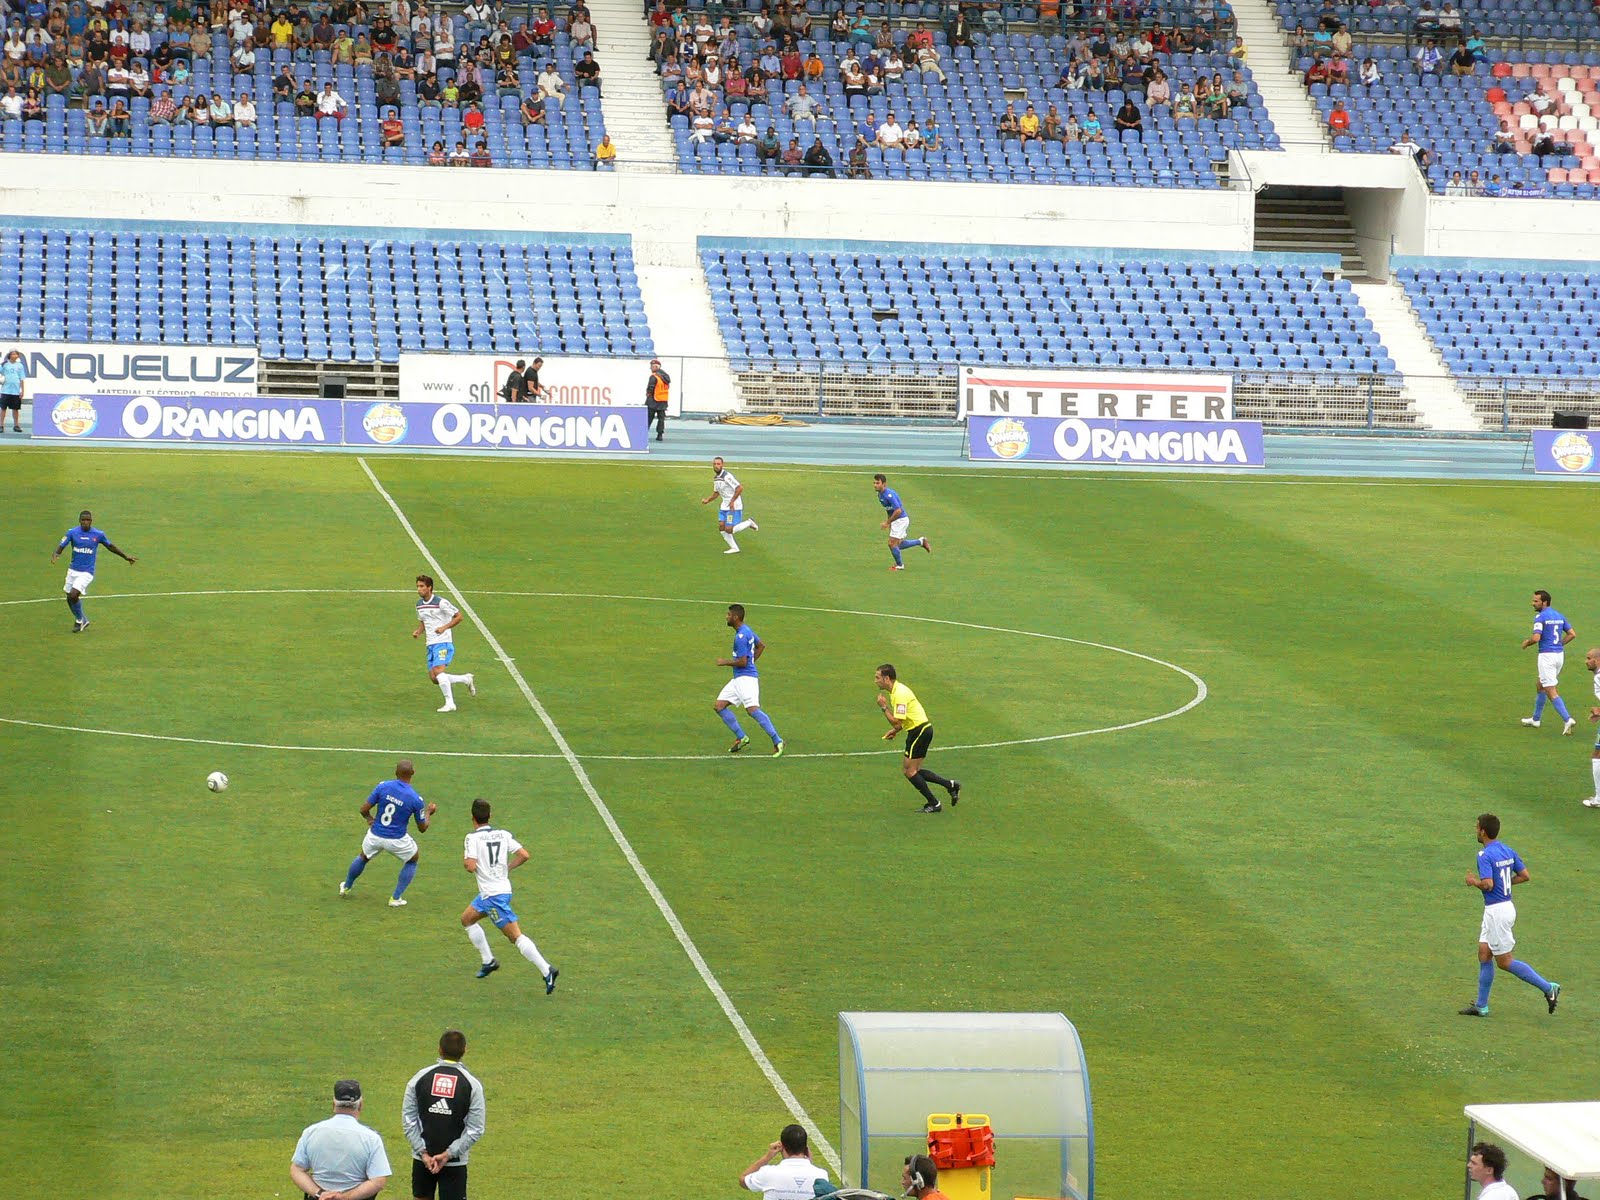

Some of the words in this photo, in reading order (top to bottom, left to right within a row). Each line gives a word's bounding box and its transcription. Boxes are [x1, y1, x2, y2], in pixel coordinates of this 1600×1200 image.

[122, 396, 325, 441] ORANGINA
[967, 388, 1224, 420] INTERFER
[431, 404, 631, 449] ORANGINA
[1053, 418, 1247, 463] ORANGINA
[1553, 624, 1559, 644] 5
[381, 803, 395, 826] 8
[486, 841, 501, 867] 17
[1500, 866, 1511, 896] 14
[428, 1107, 452, 1115] adidas
